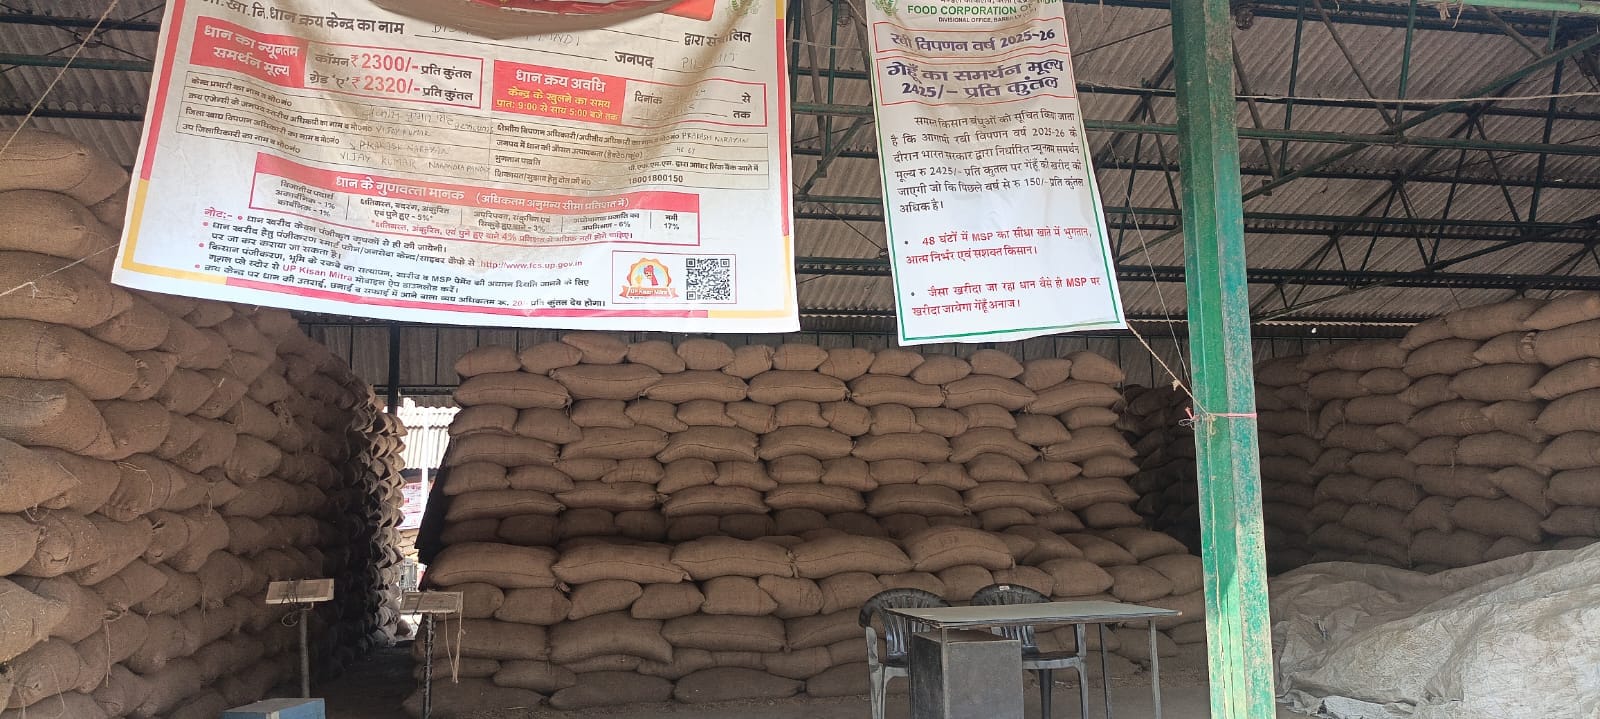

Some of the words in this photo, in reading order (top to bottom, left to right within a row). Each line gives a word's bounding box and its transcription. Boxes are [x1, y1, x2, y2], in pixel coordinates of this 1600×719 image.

[907, 5, 938, 15] FOOD
[940, 5, 1017, 16] CORPORATION
[326, 12, 354, 31] केन्द्र
[357, 19, 376, 32] का
[379, 20, 404, 34] नाम
[204, 24, 232, 41] धान
[234, 35, 256, 49] का
[258, 41, 299, 60] न्यूनतम
[684, 32, 705, 47] द्वारा
[916, 37, 969, 52] विपणन
[972, 37, 996, 51] वर्ष
[1000, 29, 1056, 49] 2025-26
[213, 46, 260, 70] समर्थन
[263, 61, 290, 78] मूल्य
[315, 52, 349, 68] कॉमन
[420, 63, 441, 76] प्रति
[443, 66, 472, 80] कुंतल
[614, 50, 655, 69] जनपद
[516, 69, 541, 84] धान
[544, 75, 568, 87] क्रय
[571, 77, 606, 92] अवधि
[921, 69, 948, 82] का
[952, 64, 1022, 81] समर्थन
[1028, 59, 1065, 76] मूल्य
[233, 84, 244, 93] का
[309, 72, 328, 84] ग्रेड
[422, 85, 442, 97] प्रति
[444, 87, 473, 101] कुंतल
[902, 82, 959, 99] 2425/-
[963, 84, 1001, 99] प्रति
[1007, 76, 1059, 96] कुंतल
[508, 86, 530, 99] केन्द्र
[533, 88, 544, 99] के
[546, 90, 572, 105] खुलने
[574, 95, 587, 106] का
[590, 98, 611, 108] समय
[634, 90, 662, 104] दिनांक
[741, 92, 751, 104] से
[518, 101, 538, 111] 9:00
[540, 102, 548, 112] से
[570, 108, 588, 118] 5:00
[590, 109, 603, 119] बजे
[605, 113, 619, 121] तक
[733, 110, 751, 119] तक
[936, 116, 968, 129] किसान
[1013, 110, 1039, 124] सूचित
[1057, 111, 1075, 121] जाता
[182, 123, 194, 132] उप
[890, 134, 898, 147] है
[902, 132, 917, 144] कि
[975, 128, 1009, 143] विपणन
[1012, 125, 1027, 138] वर्ष
[1032, 127, 1066, 138] 2025-26
[921, 149, 944, 160] भारत
[944, 151, 974, 162] सरकार
[975, 147, 994, 161] द्वारा
[929, 166, 962, 178] 2425/-
[963, 165, 982, 177] प्रति
[1010, 163, 1022, 174] पर
[1049, 160, 1070, 171] खरीद
[335, 176, 358, 189] धान
[360, 177, 374, 190] के
[376, 180, 426, 198] गुणवत्ता
[428, 188, 465, 200] मानक
[476, 191, 525, 208] (अधिकतम
[526, 198, 561, 213] अनुमन्य
[562, 196, 584, 210] सीमा
[584, 199, 614, 212] प्रतिशत
[896, 182, 927, 198] जाएगी
[929, 180, 941, 192] जो
[944, 179, 957, 192] कि
[958, 179, 983, 193] पिछले
[984, 179, 999, 192] वर्ष
[1001, 179, 1011, 191] से
[1048, 176, 1063, 188] प्रति
[899, 200, 930, 213] अधिक
[212, 221, 230, 231] धान
[232, 223, 258, 235] खरीद
[260, 227, 274, 239] हेतु
[276, 229, 316, 244] पंजीकरण
[246, 214, 264, 224] धान
[265, 216, 291, 228] खरीद
[403, 240, 415, 250] की
[922, 236, 935, 246] 48
[961, 232, 969, 242] में
[971, 233, 993, 242] MSP
[995, 230, 1010, 240] का
[1011, 227, 1034, 239] सीधा
[1036, 226, 1051, 237] खाते
[1053, 226, 1061, 236] में
[211, 232, 223, 241] पर
[227, 234, 239, 243] जा
[241, 236, 256, 245] कर
[259, 238, 286, 250] कराया
[288, 243, 300, 252] जा
[302, 245, 329, 256] सकता
[208, 240, 239, 254] किसान
[343, 261, 355, 272] का
[431, 275, 452, 283] MSP
[480, 260, 583, 270] http://www.fcs.up.gov.in
[906, 254, 929, 265] आत्म
[957, 247, 972, 262] एवं
[1003, 245, 1038, 257] किसान।
[247, 269, 260, 279] पर
[262, 272, 280, 282] धान
[282, 264, 297, 273] UP
[299, 266, 327, 277] Kisan
[328, 270, 353, 282] Mitra
[928, 283, 949, 298] जैसा
[953, 282, 982, 296] खरीदा
[986, 283, 998, 293] जा
[1001, 281, 1015, 293] रहा
[1019, 281, 1036, 291] धान
[1054, 278, 1063, 289] ही
[1066, 277, 1087, 288] MSP
[1089, 277, 1101, 287] पर
[911, 304, 941, 317] खरीदा
